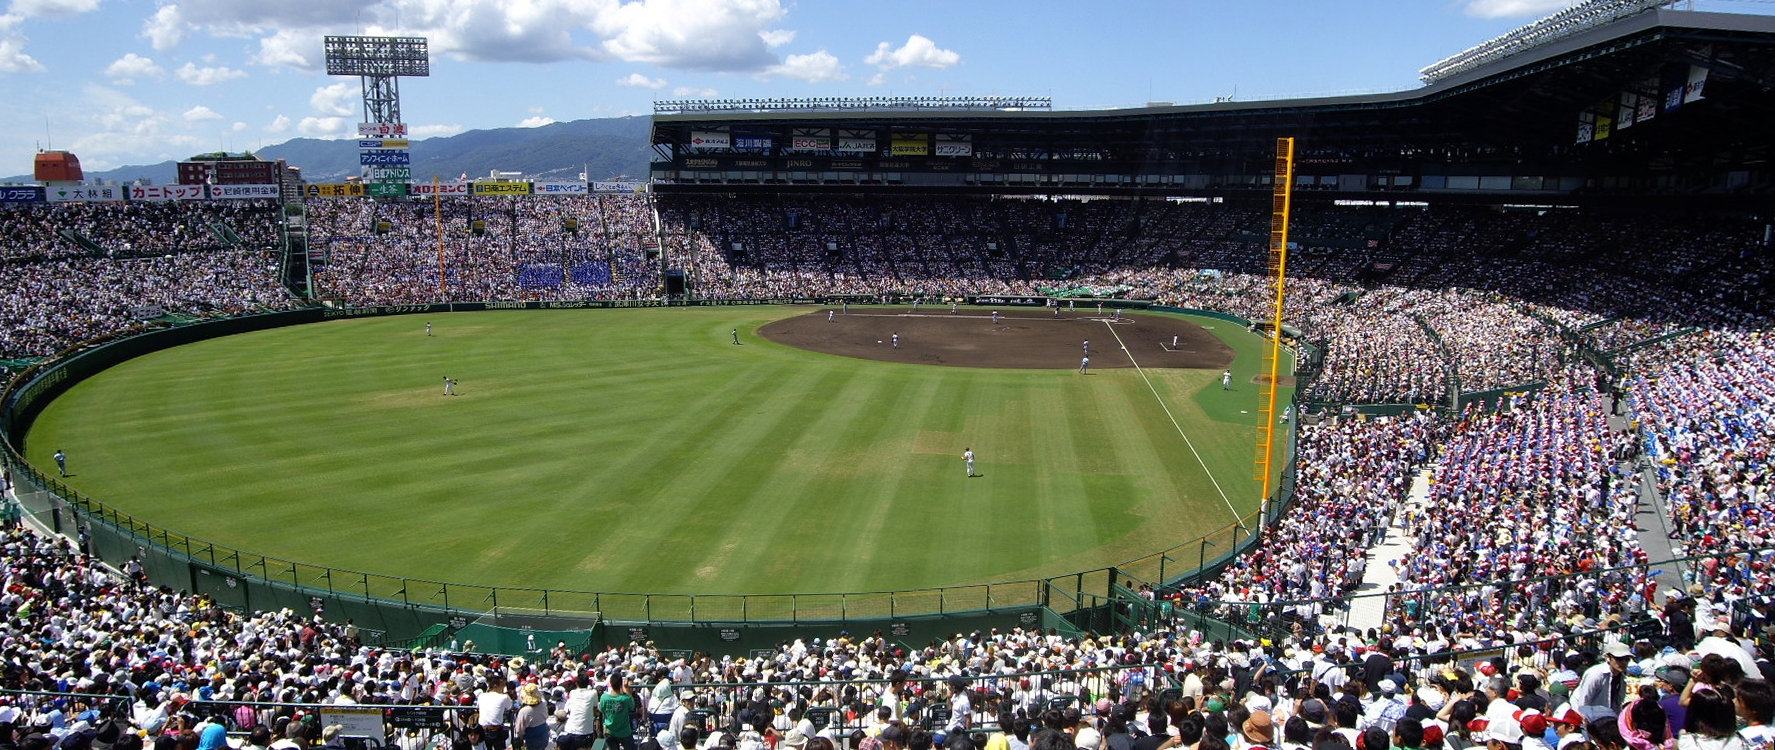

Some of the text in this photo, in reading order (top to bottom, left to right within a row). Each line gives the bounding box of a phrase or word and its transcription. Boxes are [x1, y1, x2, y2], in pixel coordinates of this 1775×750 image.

[379, 122, 405, 135] 白波
[795, 139, 817, 148] ECC
[937, 145, 971, 154] サニクリーン
[787, 159, 812, 168] JINRO
[133, 186, 202, 199] カニトップ
[223, 186, 278, 196] 尼崎信用金庫
[484, 184, 527, 192] 日商エステム
[546, 184, 587, 192] 日本ペイント
[73, 188, 113, 198] 大林組
[485, 301, 527, 309] SHIMANO
